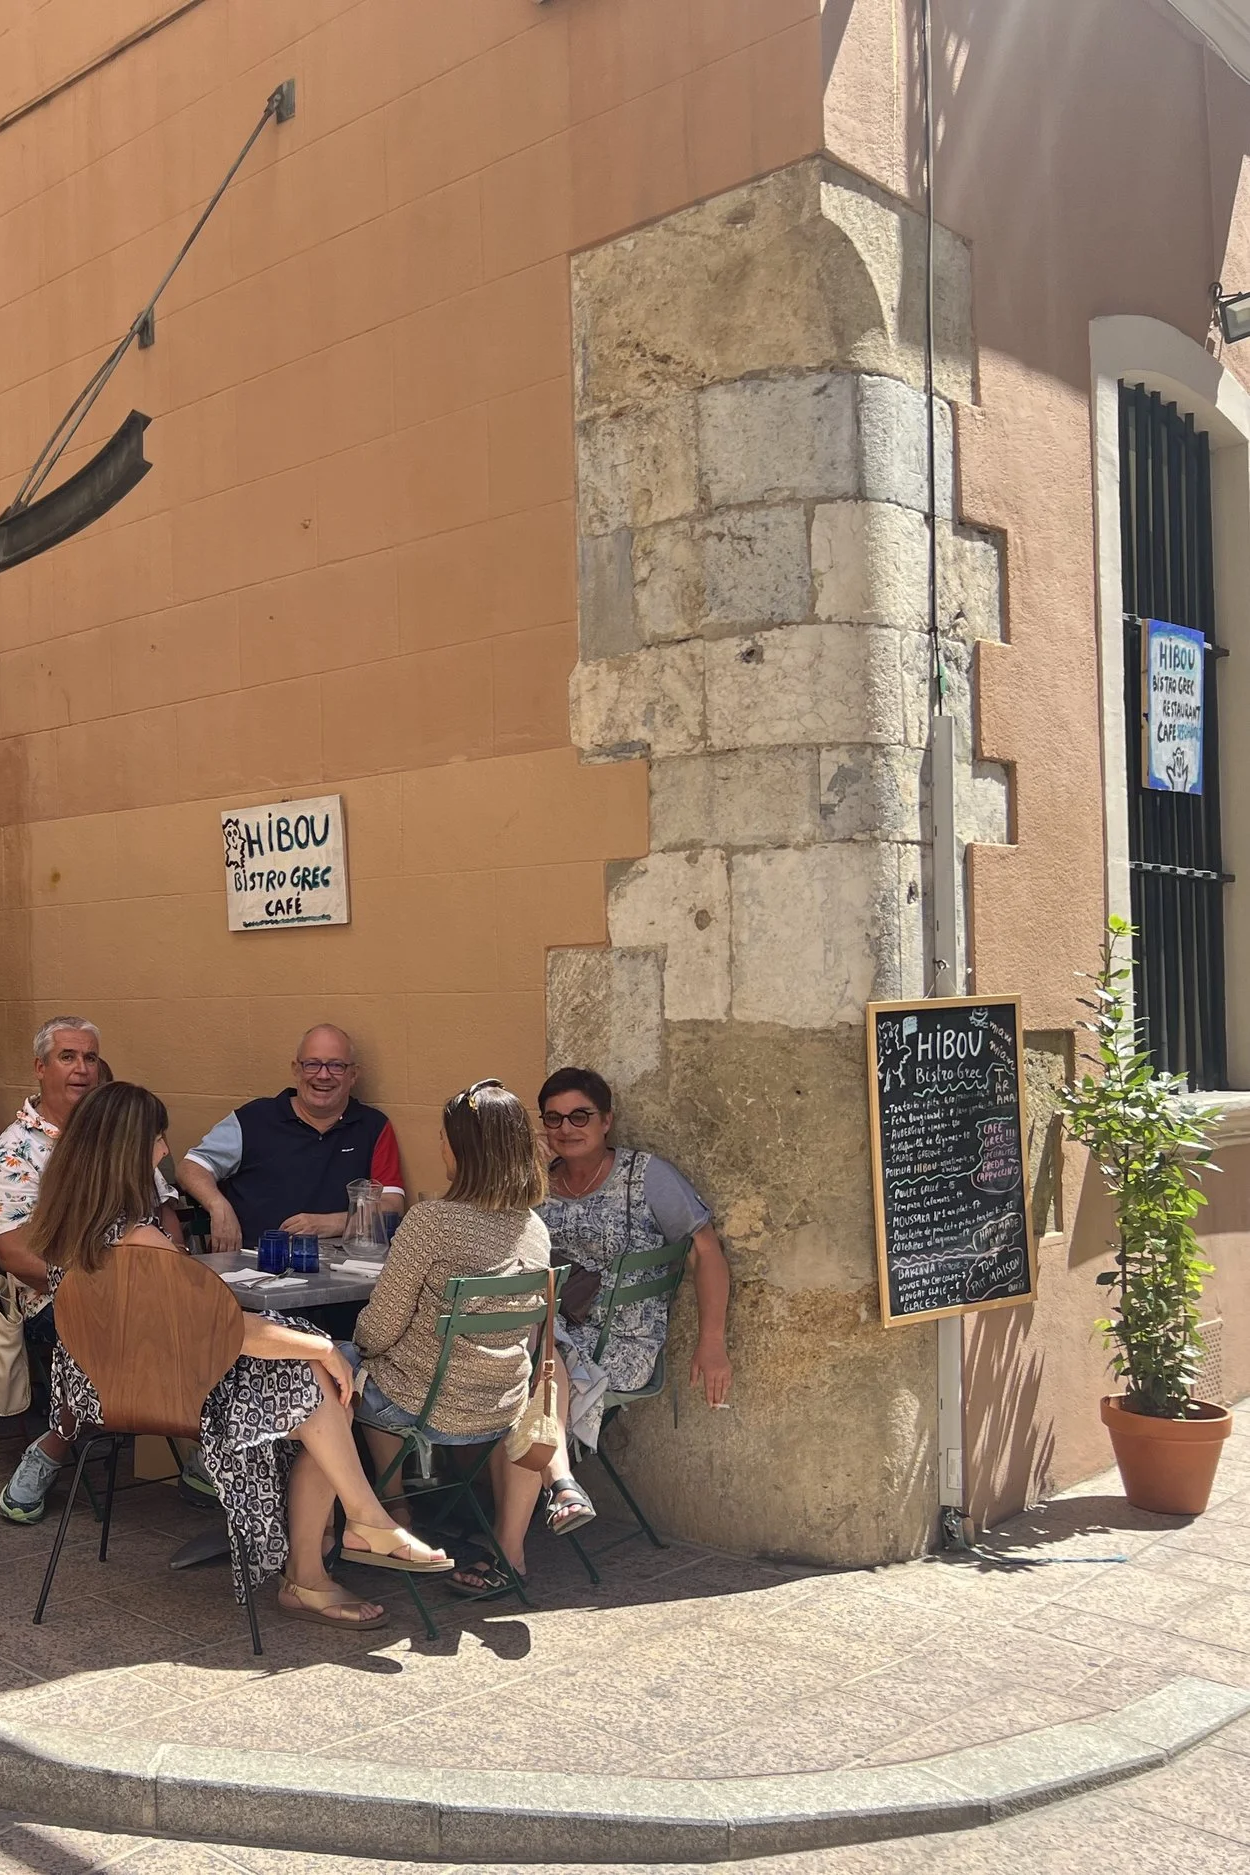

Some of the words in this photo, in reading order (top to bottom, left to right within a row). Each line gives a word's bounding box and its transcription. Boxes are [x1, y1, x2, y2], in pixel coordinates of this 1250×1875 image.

[1162, 700, 1201, 721] RESTAURANT
[291, 866, 332, 891] GREC
[265, 892, 302, 917] CAFÉ
[916, 1064, 952, 1084] Bistro
[957, 1062, 983, 1079] Grec
[892, 1213, 930, 1228] MOUSSAKA
[898, 1263, 936, 1280] BAKLAVA
[978, 1252, 999, 1274] TOUT
[970, 1277, 986, 1294] FAIT
[989, 1256, 1020, 1282] MAISON
[900, 1290, 925, 1303] NOUGAT
[903, 1297, 938, 1312] GLACES
